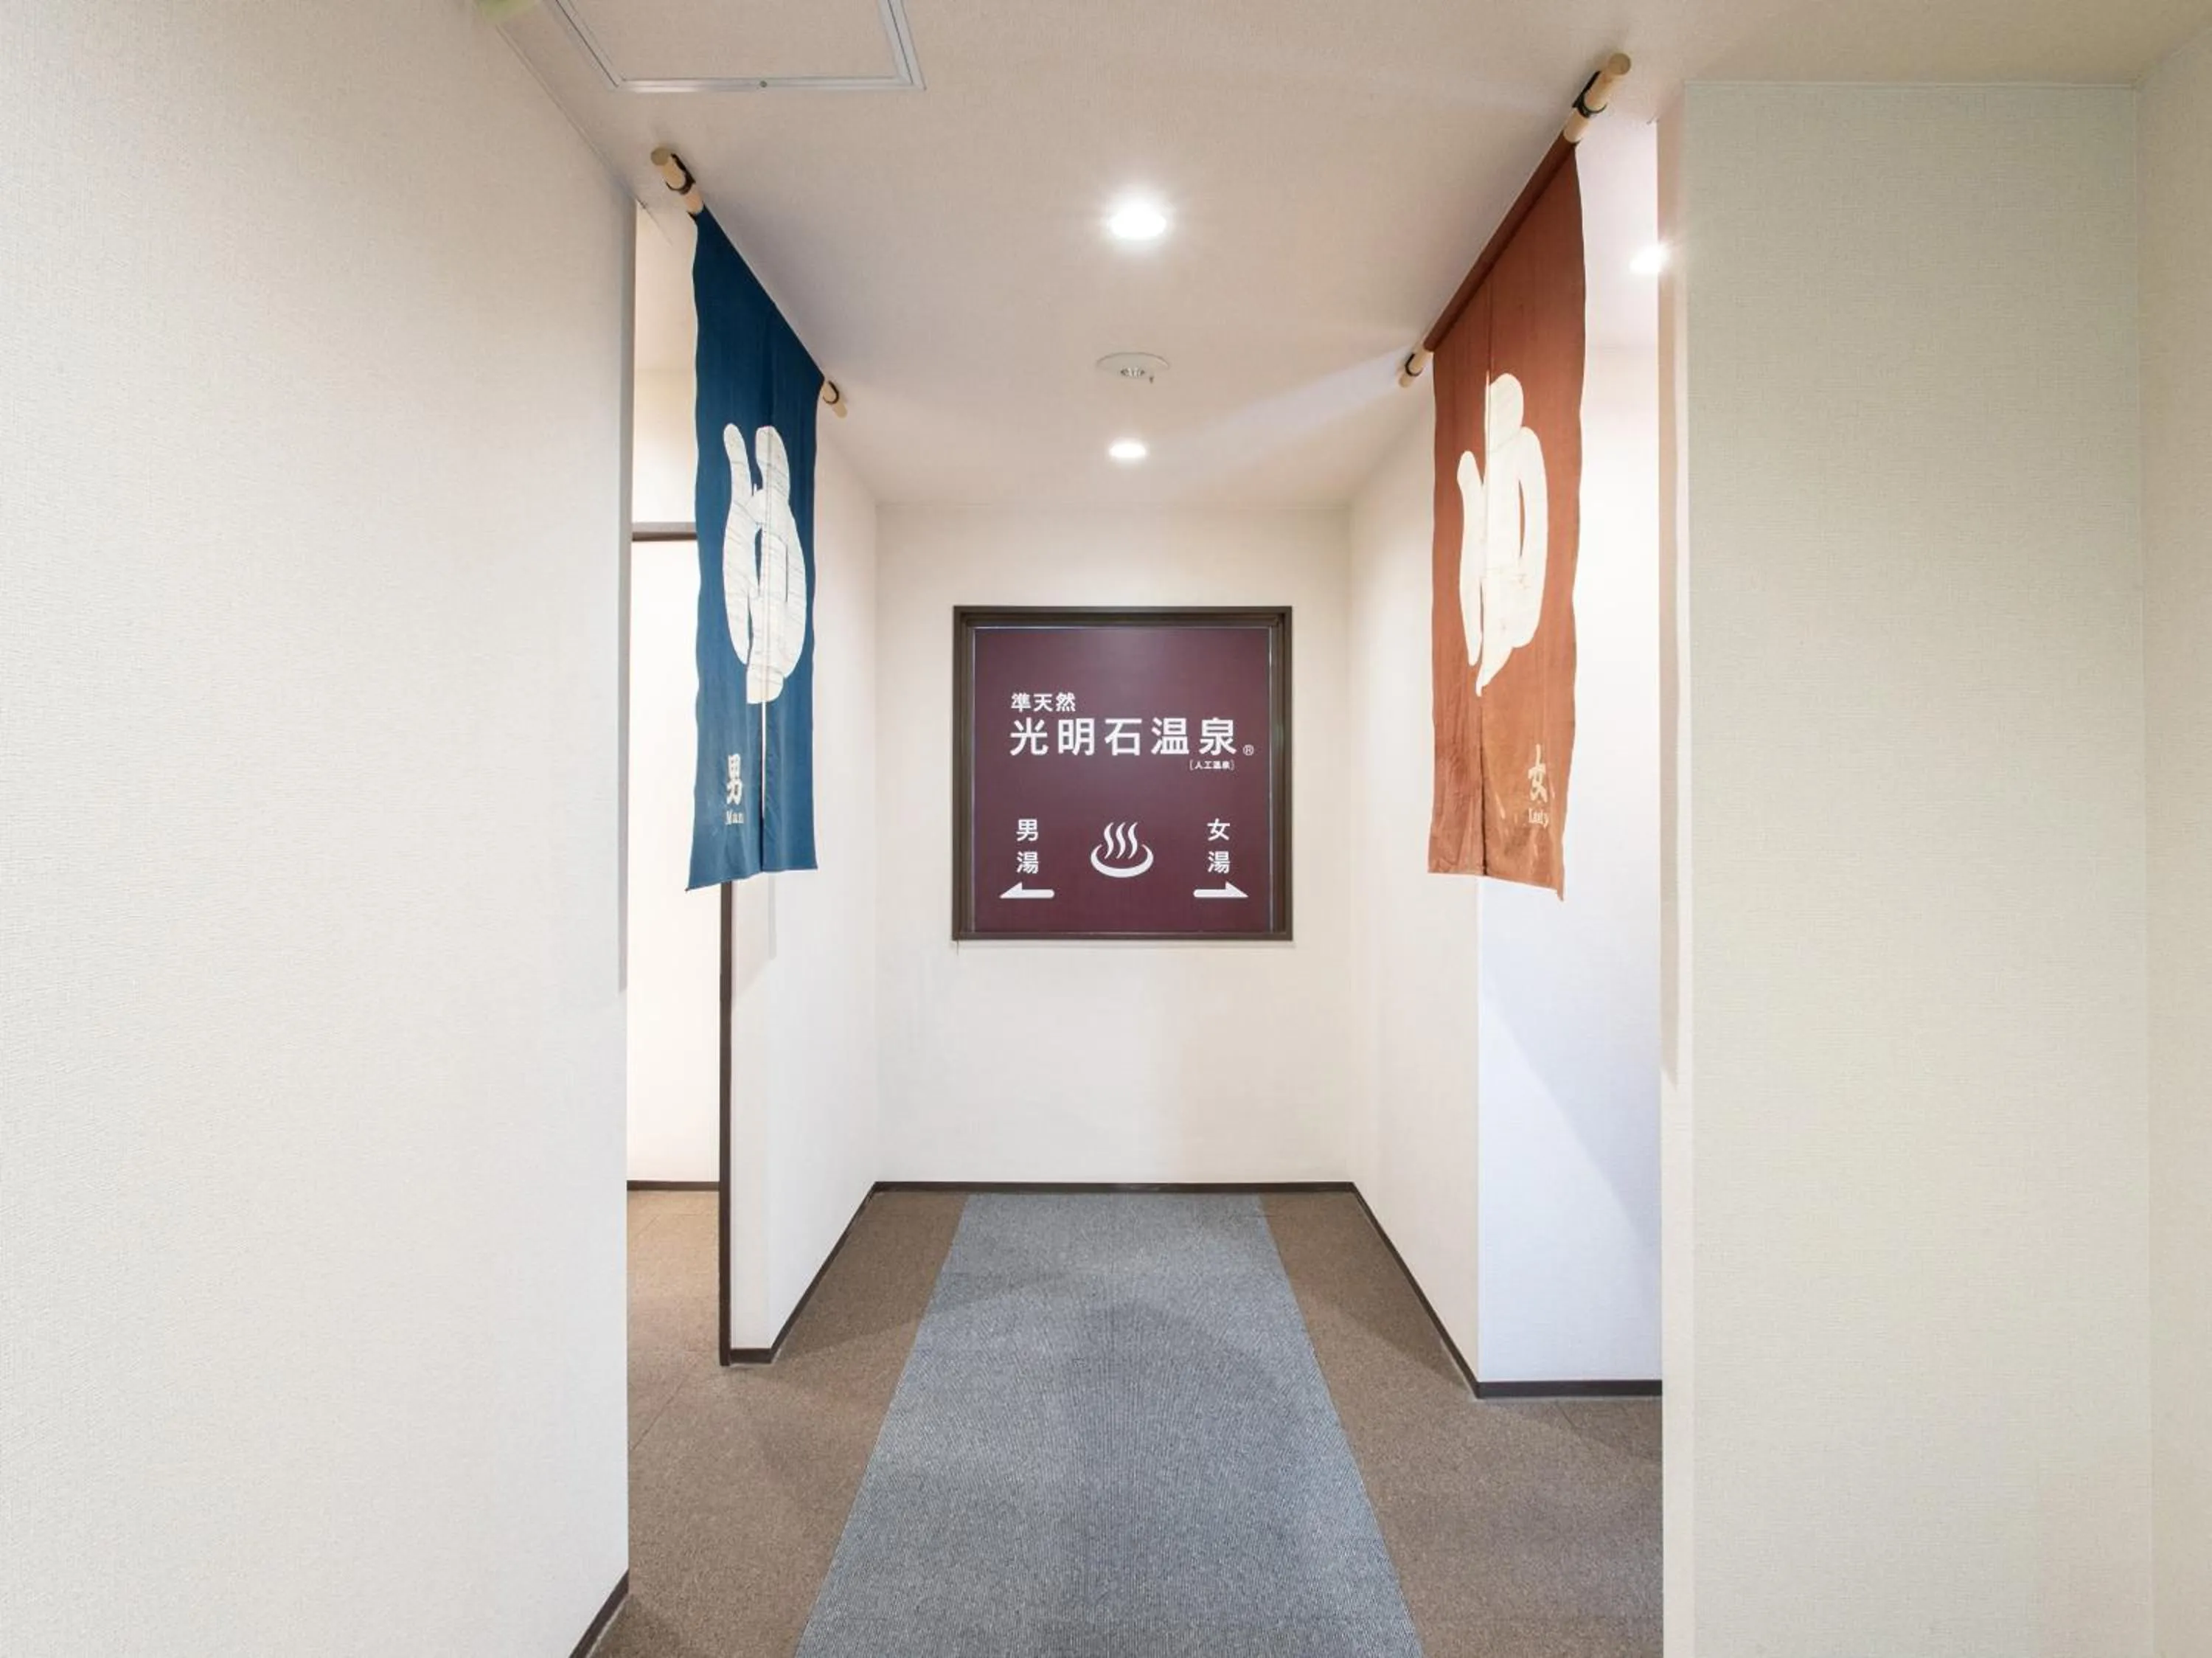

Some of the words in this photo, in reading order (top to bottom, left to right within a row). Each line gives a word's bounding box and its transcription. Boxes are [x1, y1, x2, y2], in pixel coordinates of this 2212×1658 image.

[1011, 692, 1076, 712] 準天然
[726, 753, 743, 805] 男
[1528, 744, 1548, 802] 女
[1016, 819, 1038, 874] 男湯
[1207, 818, 1231, 874] 女湯
